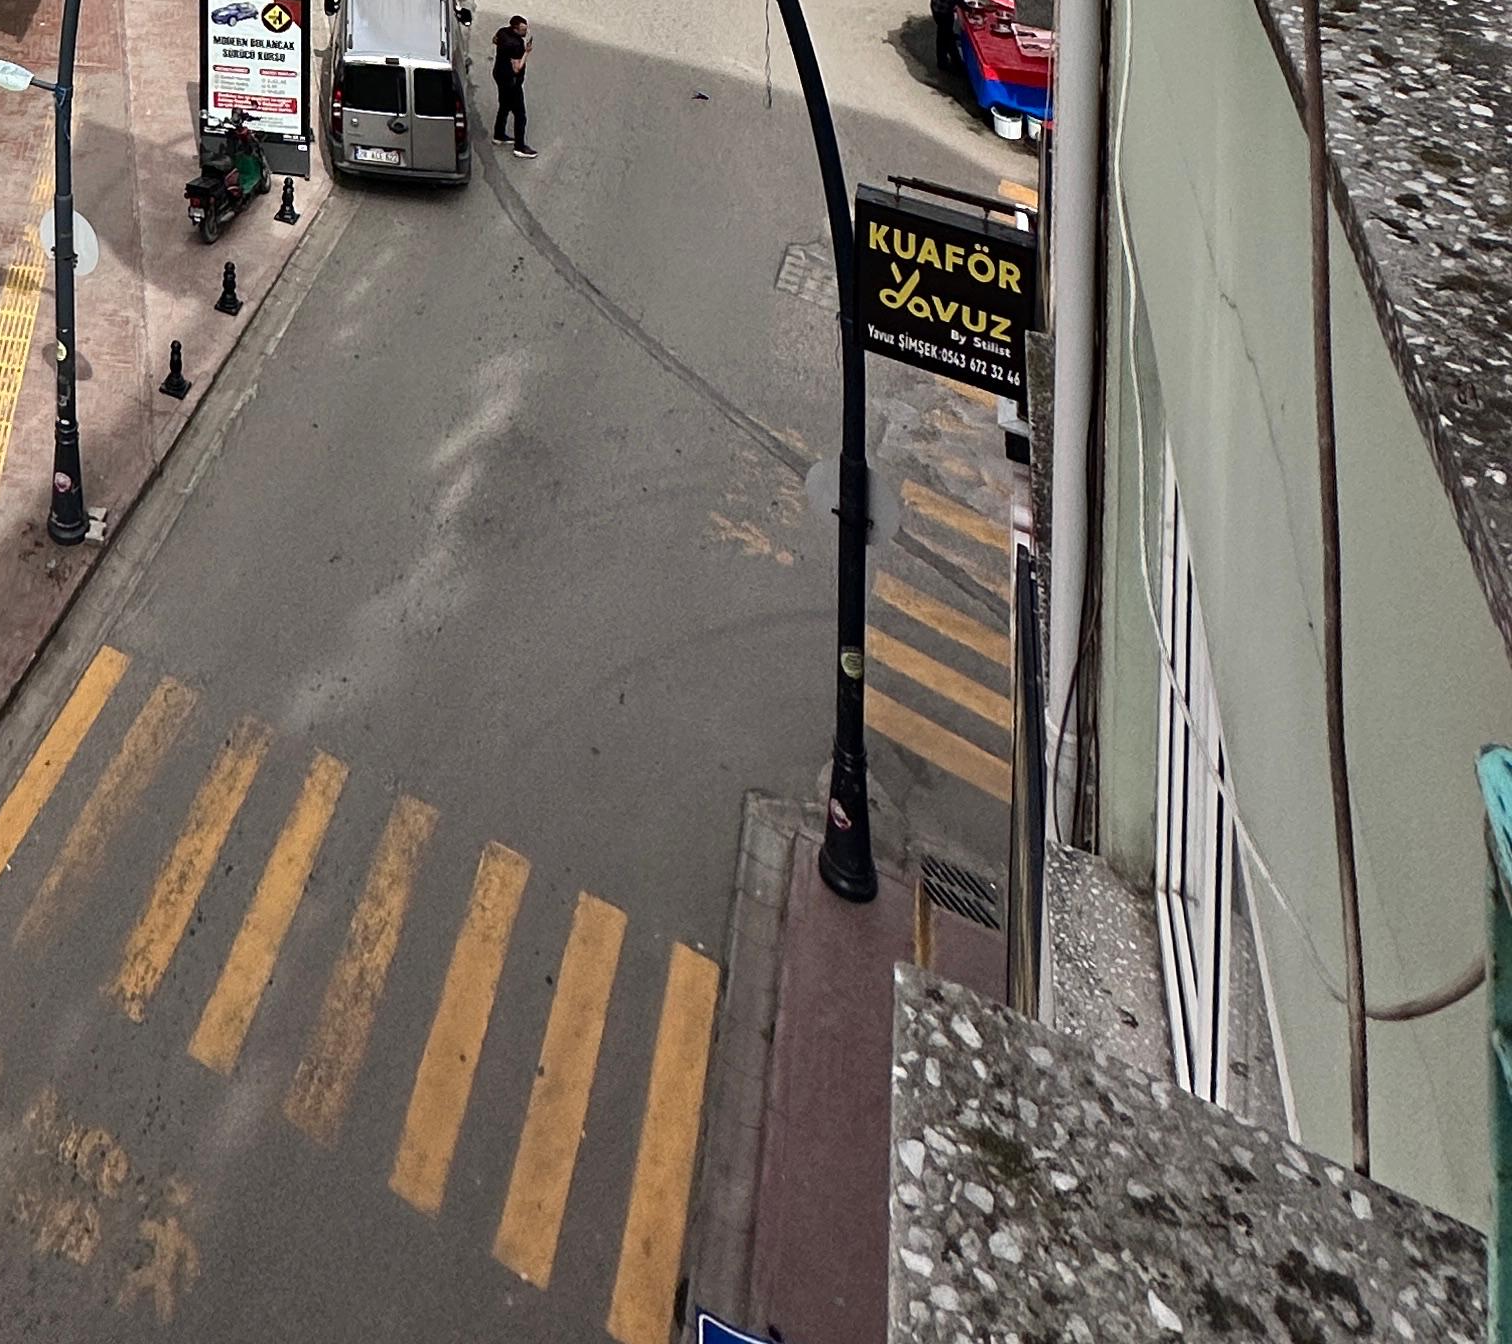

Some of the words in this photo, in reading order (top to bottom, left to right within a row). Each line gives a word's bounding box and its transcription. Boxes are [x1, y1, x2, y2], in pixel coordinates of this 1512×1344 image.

[869, 221, 1022, 294] KUAFÖR
[867, 323, 895, 346] Yavuz
[969, 357, 987, 376] 672
[990, 362, 1004, 381] 32
[1007, 369, 1021, 387] 46
[950, 329, 967, 345] By
[973, 338, 1012, 359] Stilist
